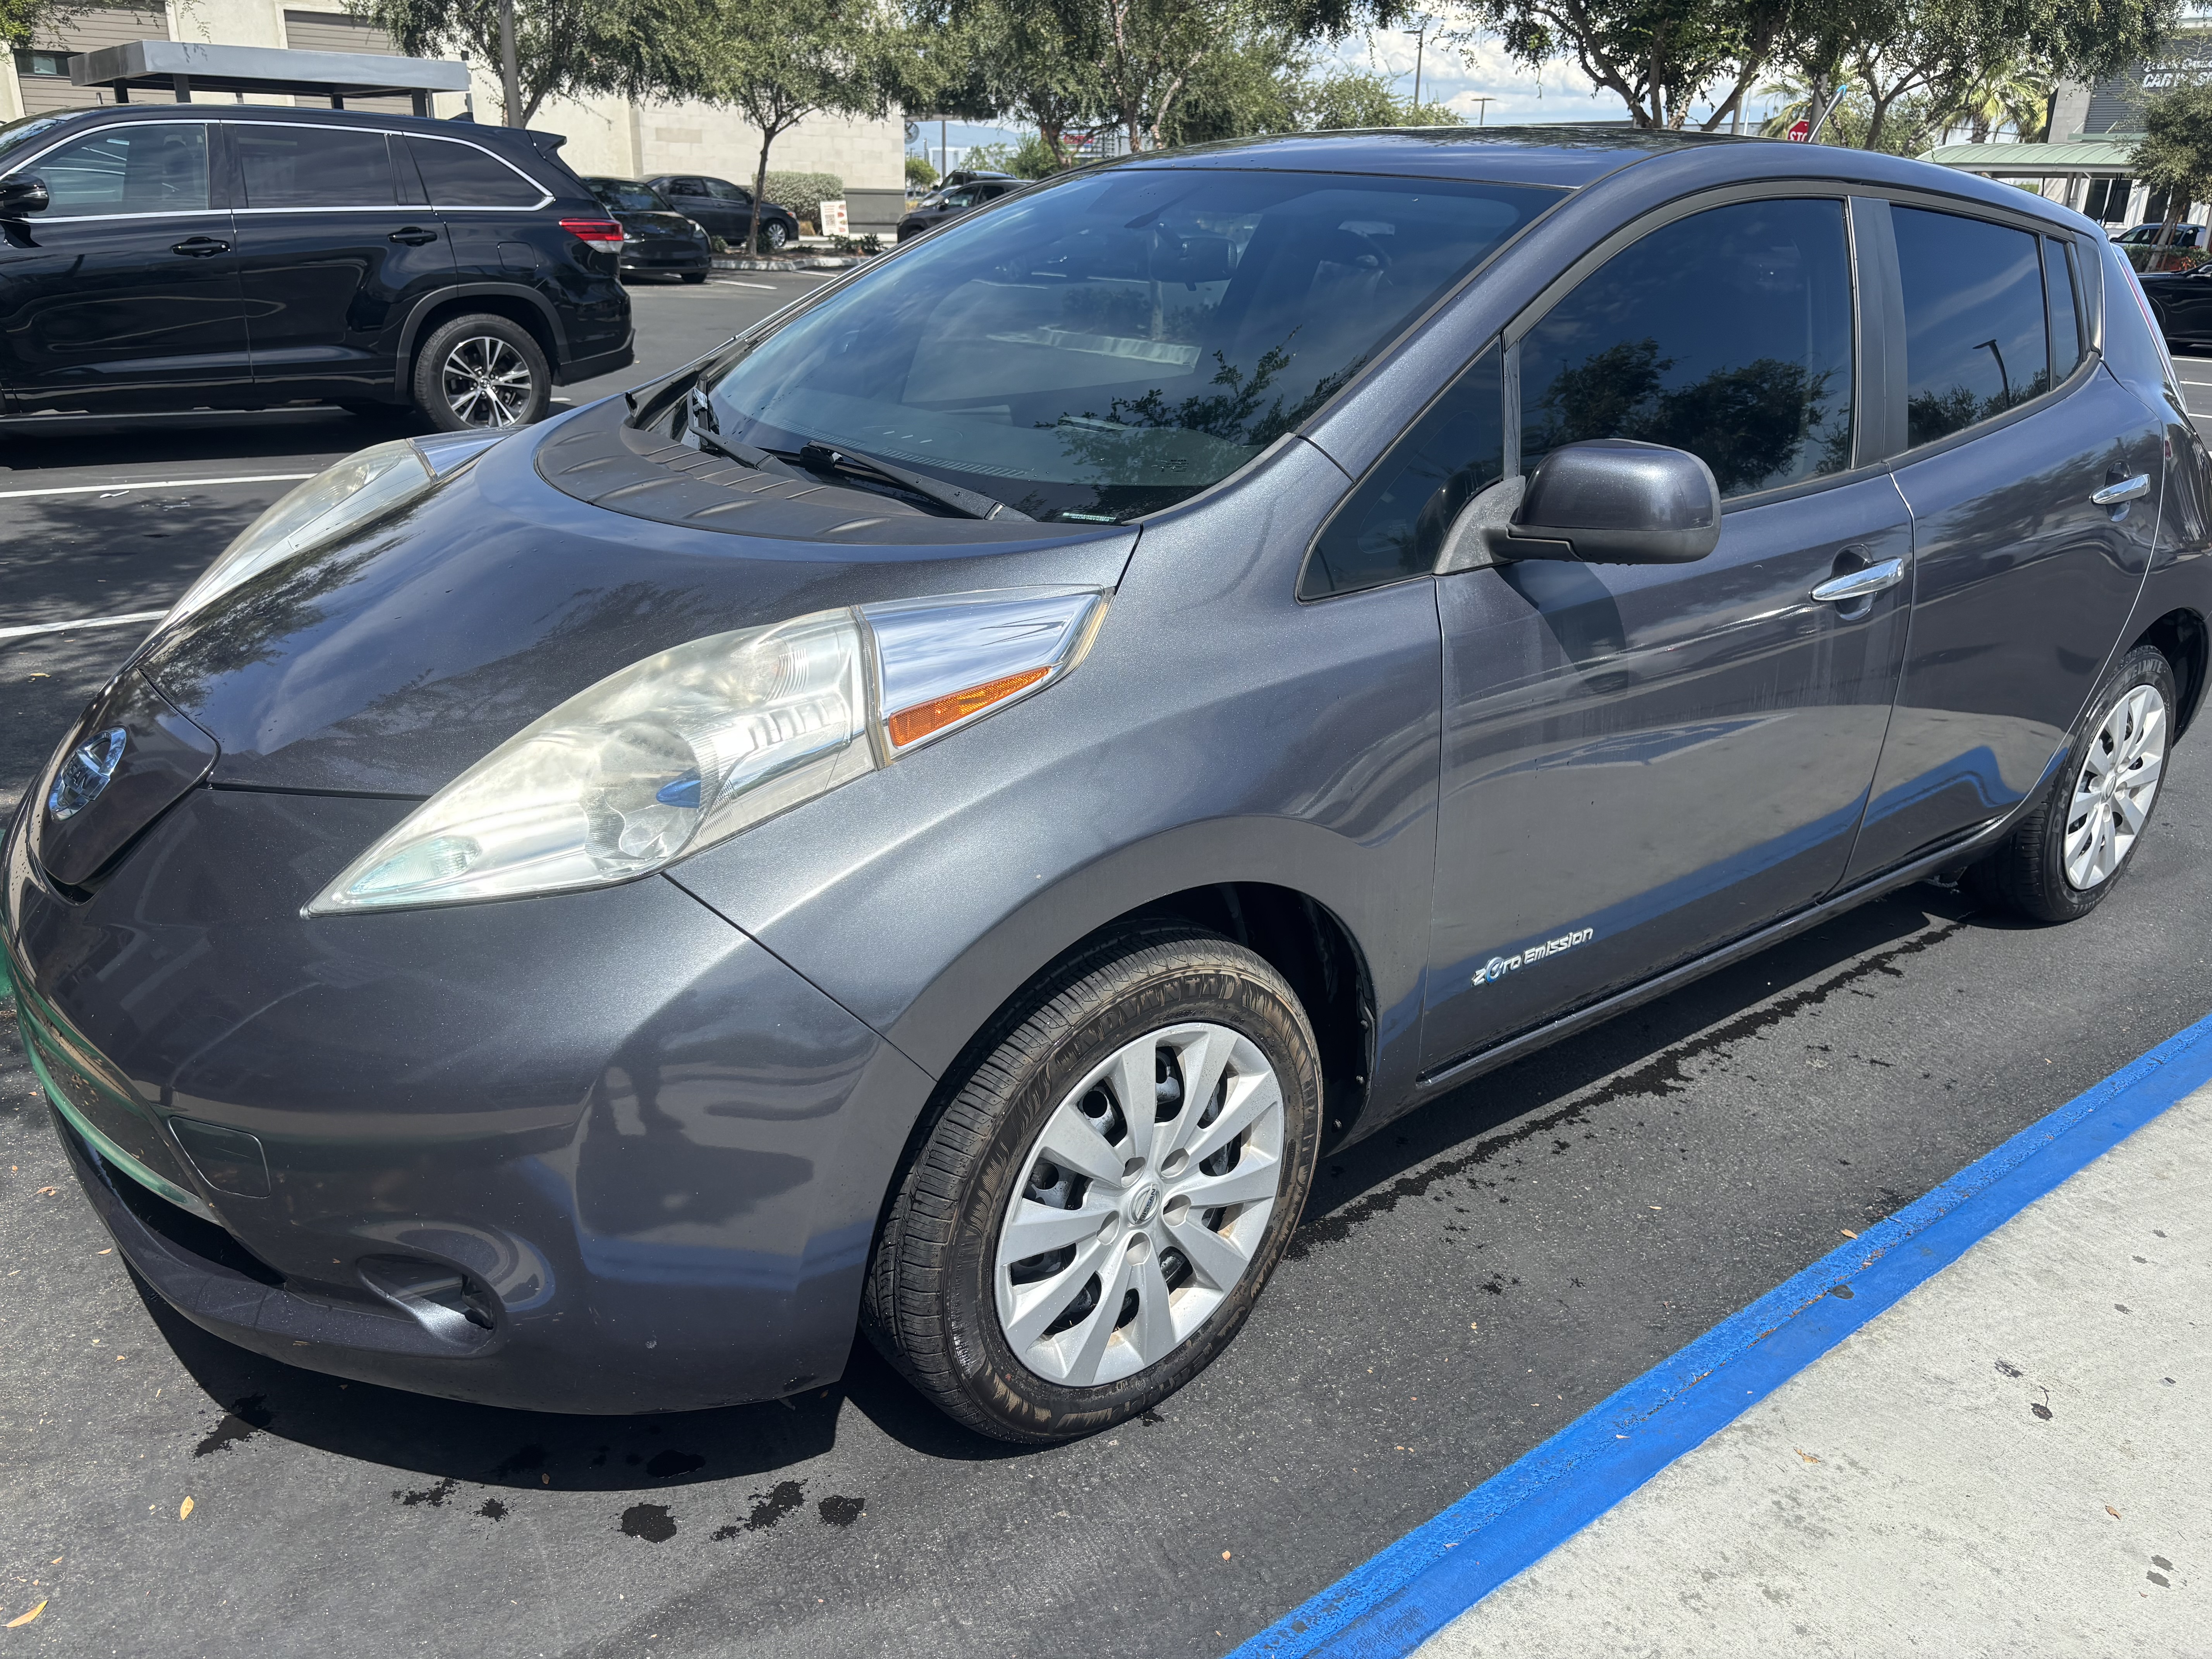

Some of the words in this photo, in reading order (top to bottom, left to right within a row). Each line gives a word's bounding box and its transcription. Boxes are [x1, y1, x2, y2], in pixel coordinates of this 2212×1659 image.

[2142, 73, 2173, 88] CAR
[1524, 927, 1593, 964] Emission
[1139, 1188, 1156, 1221] NISSAN
